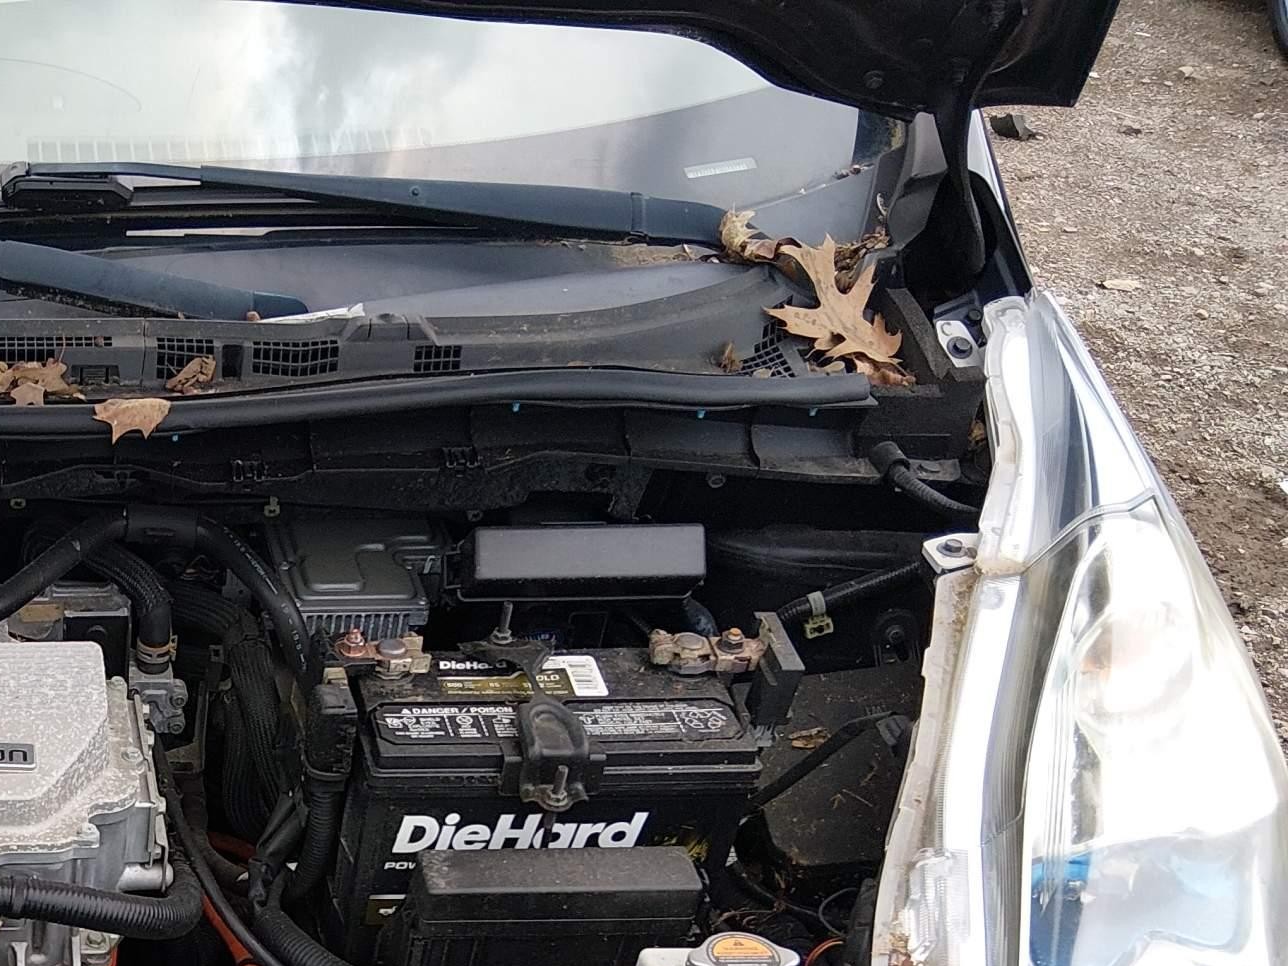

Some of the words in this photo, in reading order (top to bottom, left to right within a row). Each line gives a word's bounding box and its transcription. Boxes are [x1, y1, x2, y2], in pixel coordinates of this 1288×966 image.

[412, 706, 459, 714] DANGER
[470, 706, 514, 714] POISON
[391, 812, 650, 854] DieHard
